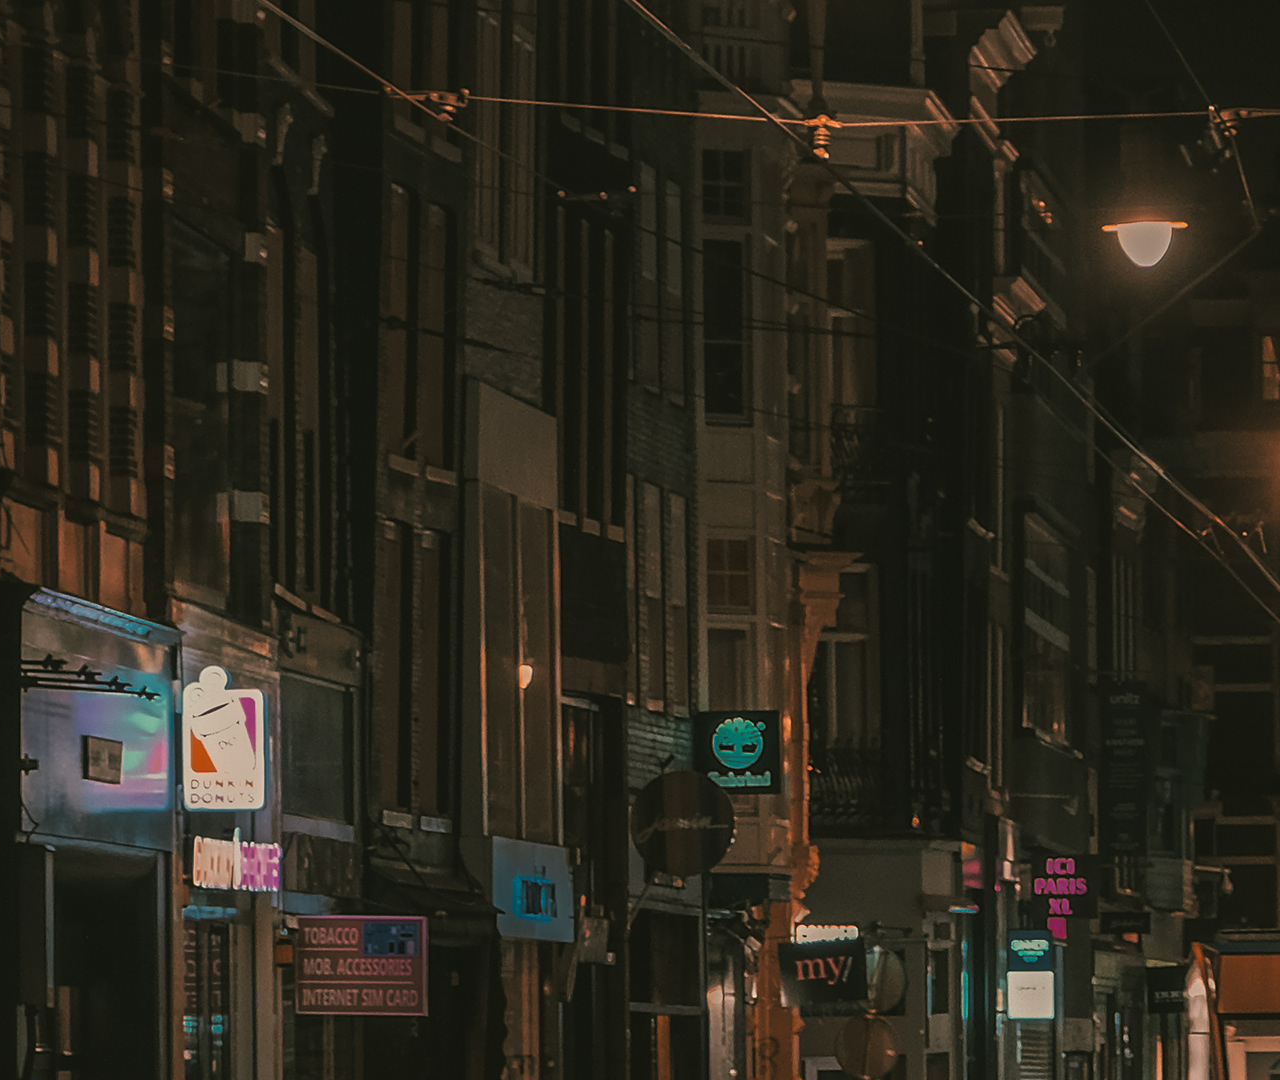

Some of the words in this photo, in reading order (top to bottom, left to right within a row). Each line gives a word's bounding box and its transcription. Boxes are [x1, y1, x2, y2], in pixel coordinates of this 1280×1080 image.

[1045, 857, 1075, 875] ICI
[1033, 877, 1088, 896] PARIS
[1048, 897, 1073, 915] XL
[303, 926, 359, 946] TOBACCO
[303, 957, 335, 976] MOB.
[336, 957, 413, 976] ACCESSORIES
[302, 987, 359, 1007] INTERNET
[361, 987, 384, 1007] SIM
[385, 988, 418, 1007] CARD
